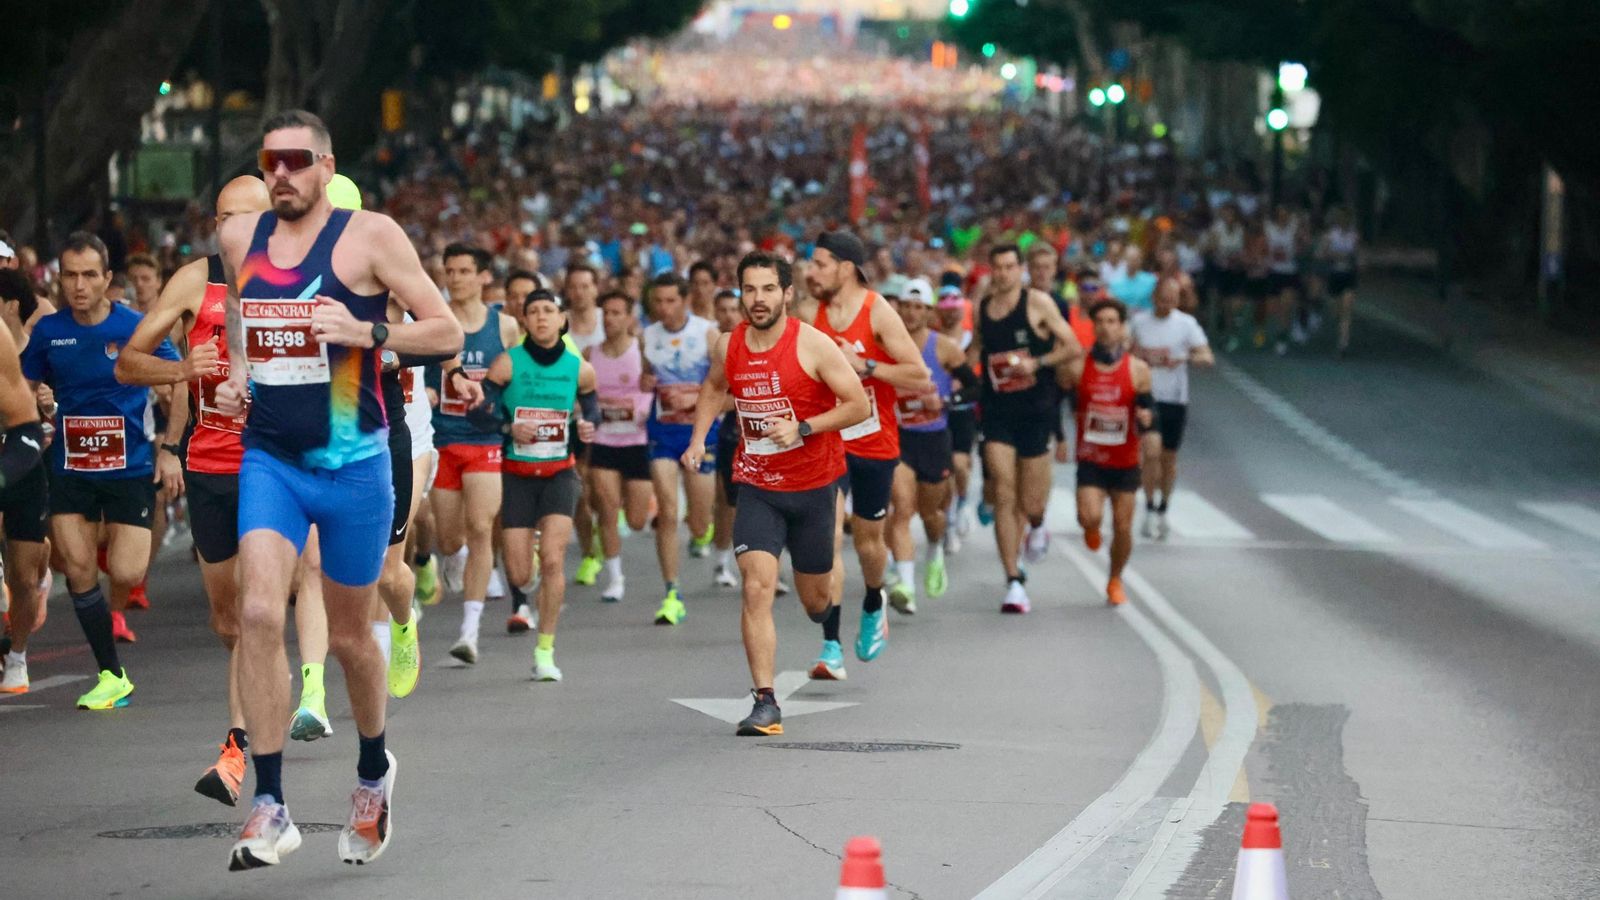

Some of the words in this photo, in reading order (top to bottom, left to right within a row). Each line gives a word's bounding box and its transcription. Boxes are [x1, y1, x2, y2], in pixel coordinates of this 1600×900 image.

[260, 304, 316, 317] GENERALI
[51, 338, 77, 346] macron
[256, 331, 305, 347] 13598
[749, 401, 786, 412] GENERALI
[79, 420, 119, 428] GENERALI
[80, 436, 109, 447] 2412
